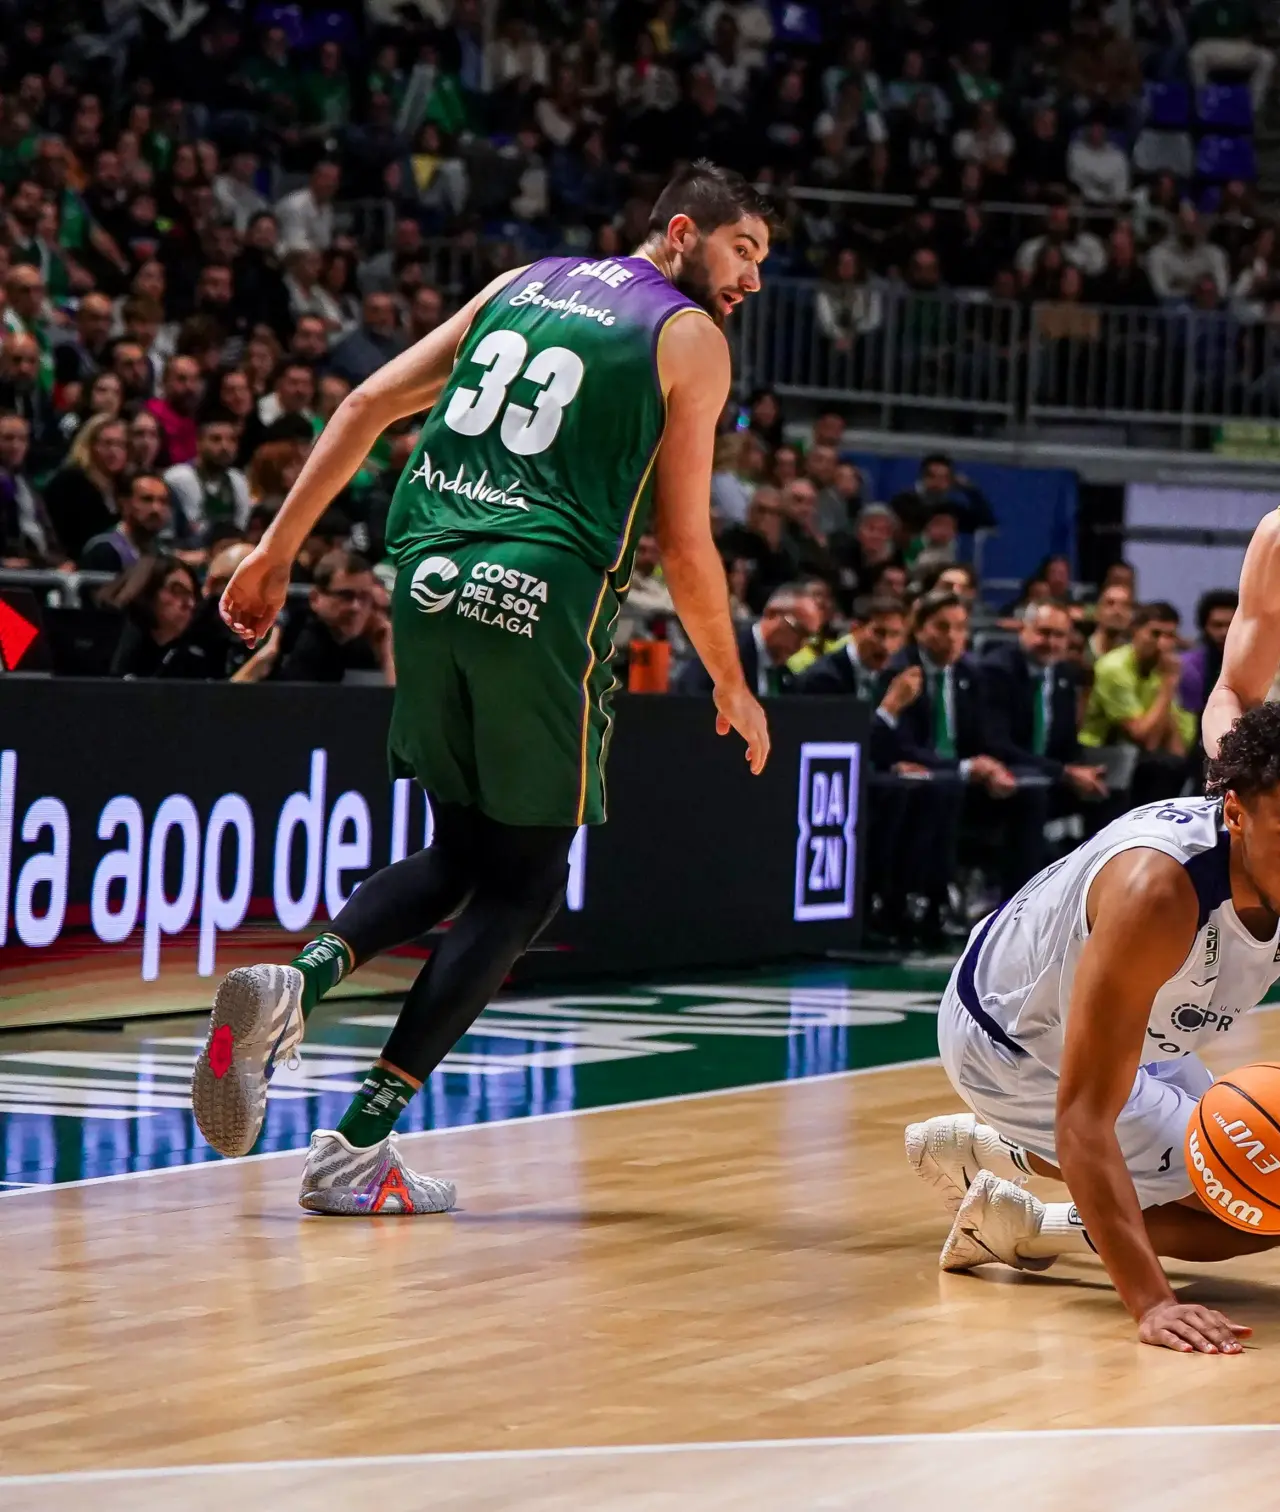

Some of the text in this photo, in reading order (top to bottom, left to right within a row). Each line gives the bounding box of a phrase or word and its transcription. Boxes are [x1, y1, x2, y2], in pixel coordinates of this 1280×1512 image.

[444, 329, 584, 456] 33
[408, 451, 530, 512] Andalucía
[461, 582, 540, 621] DEL SOL
[471, 561, 548, 603] COSTA
[456, 601, 532, 638] MÁLAGA
[0, 749, 70, 948] la
[91, 793, 255, 982] app
[273, 748, 373, 932] de
[1211, 1111, 1228, 1129] NXT
[1188, 1128, 1264, 1227] Wilson
